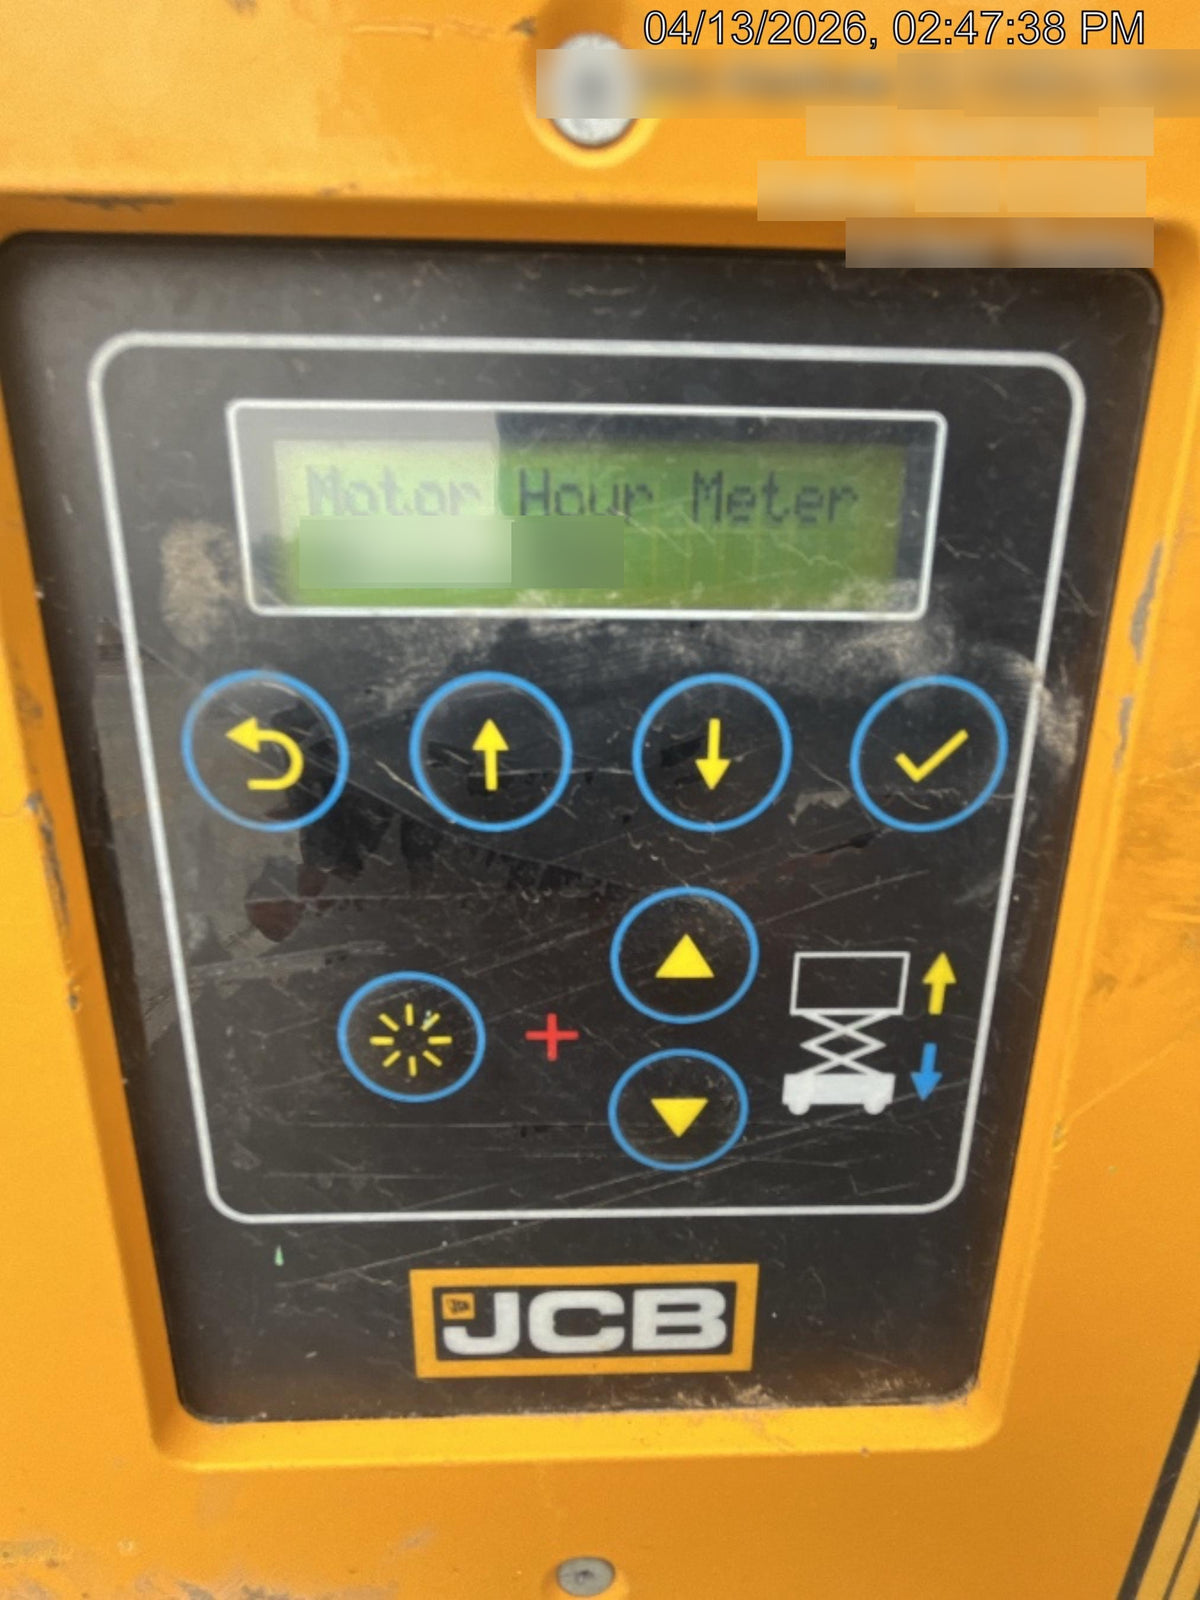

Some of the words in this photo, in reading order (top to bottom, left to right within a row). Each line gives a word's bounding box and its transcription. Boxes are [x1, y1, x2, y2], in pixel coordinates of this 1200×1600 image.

[307, 464, 480, 517] Motor
[519, 468, 654, 524] Hour
[693, 470, 858, 525] Meter
[442, 1288, 726, 1355] JCB
